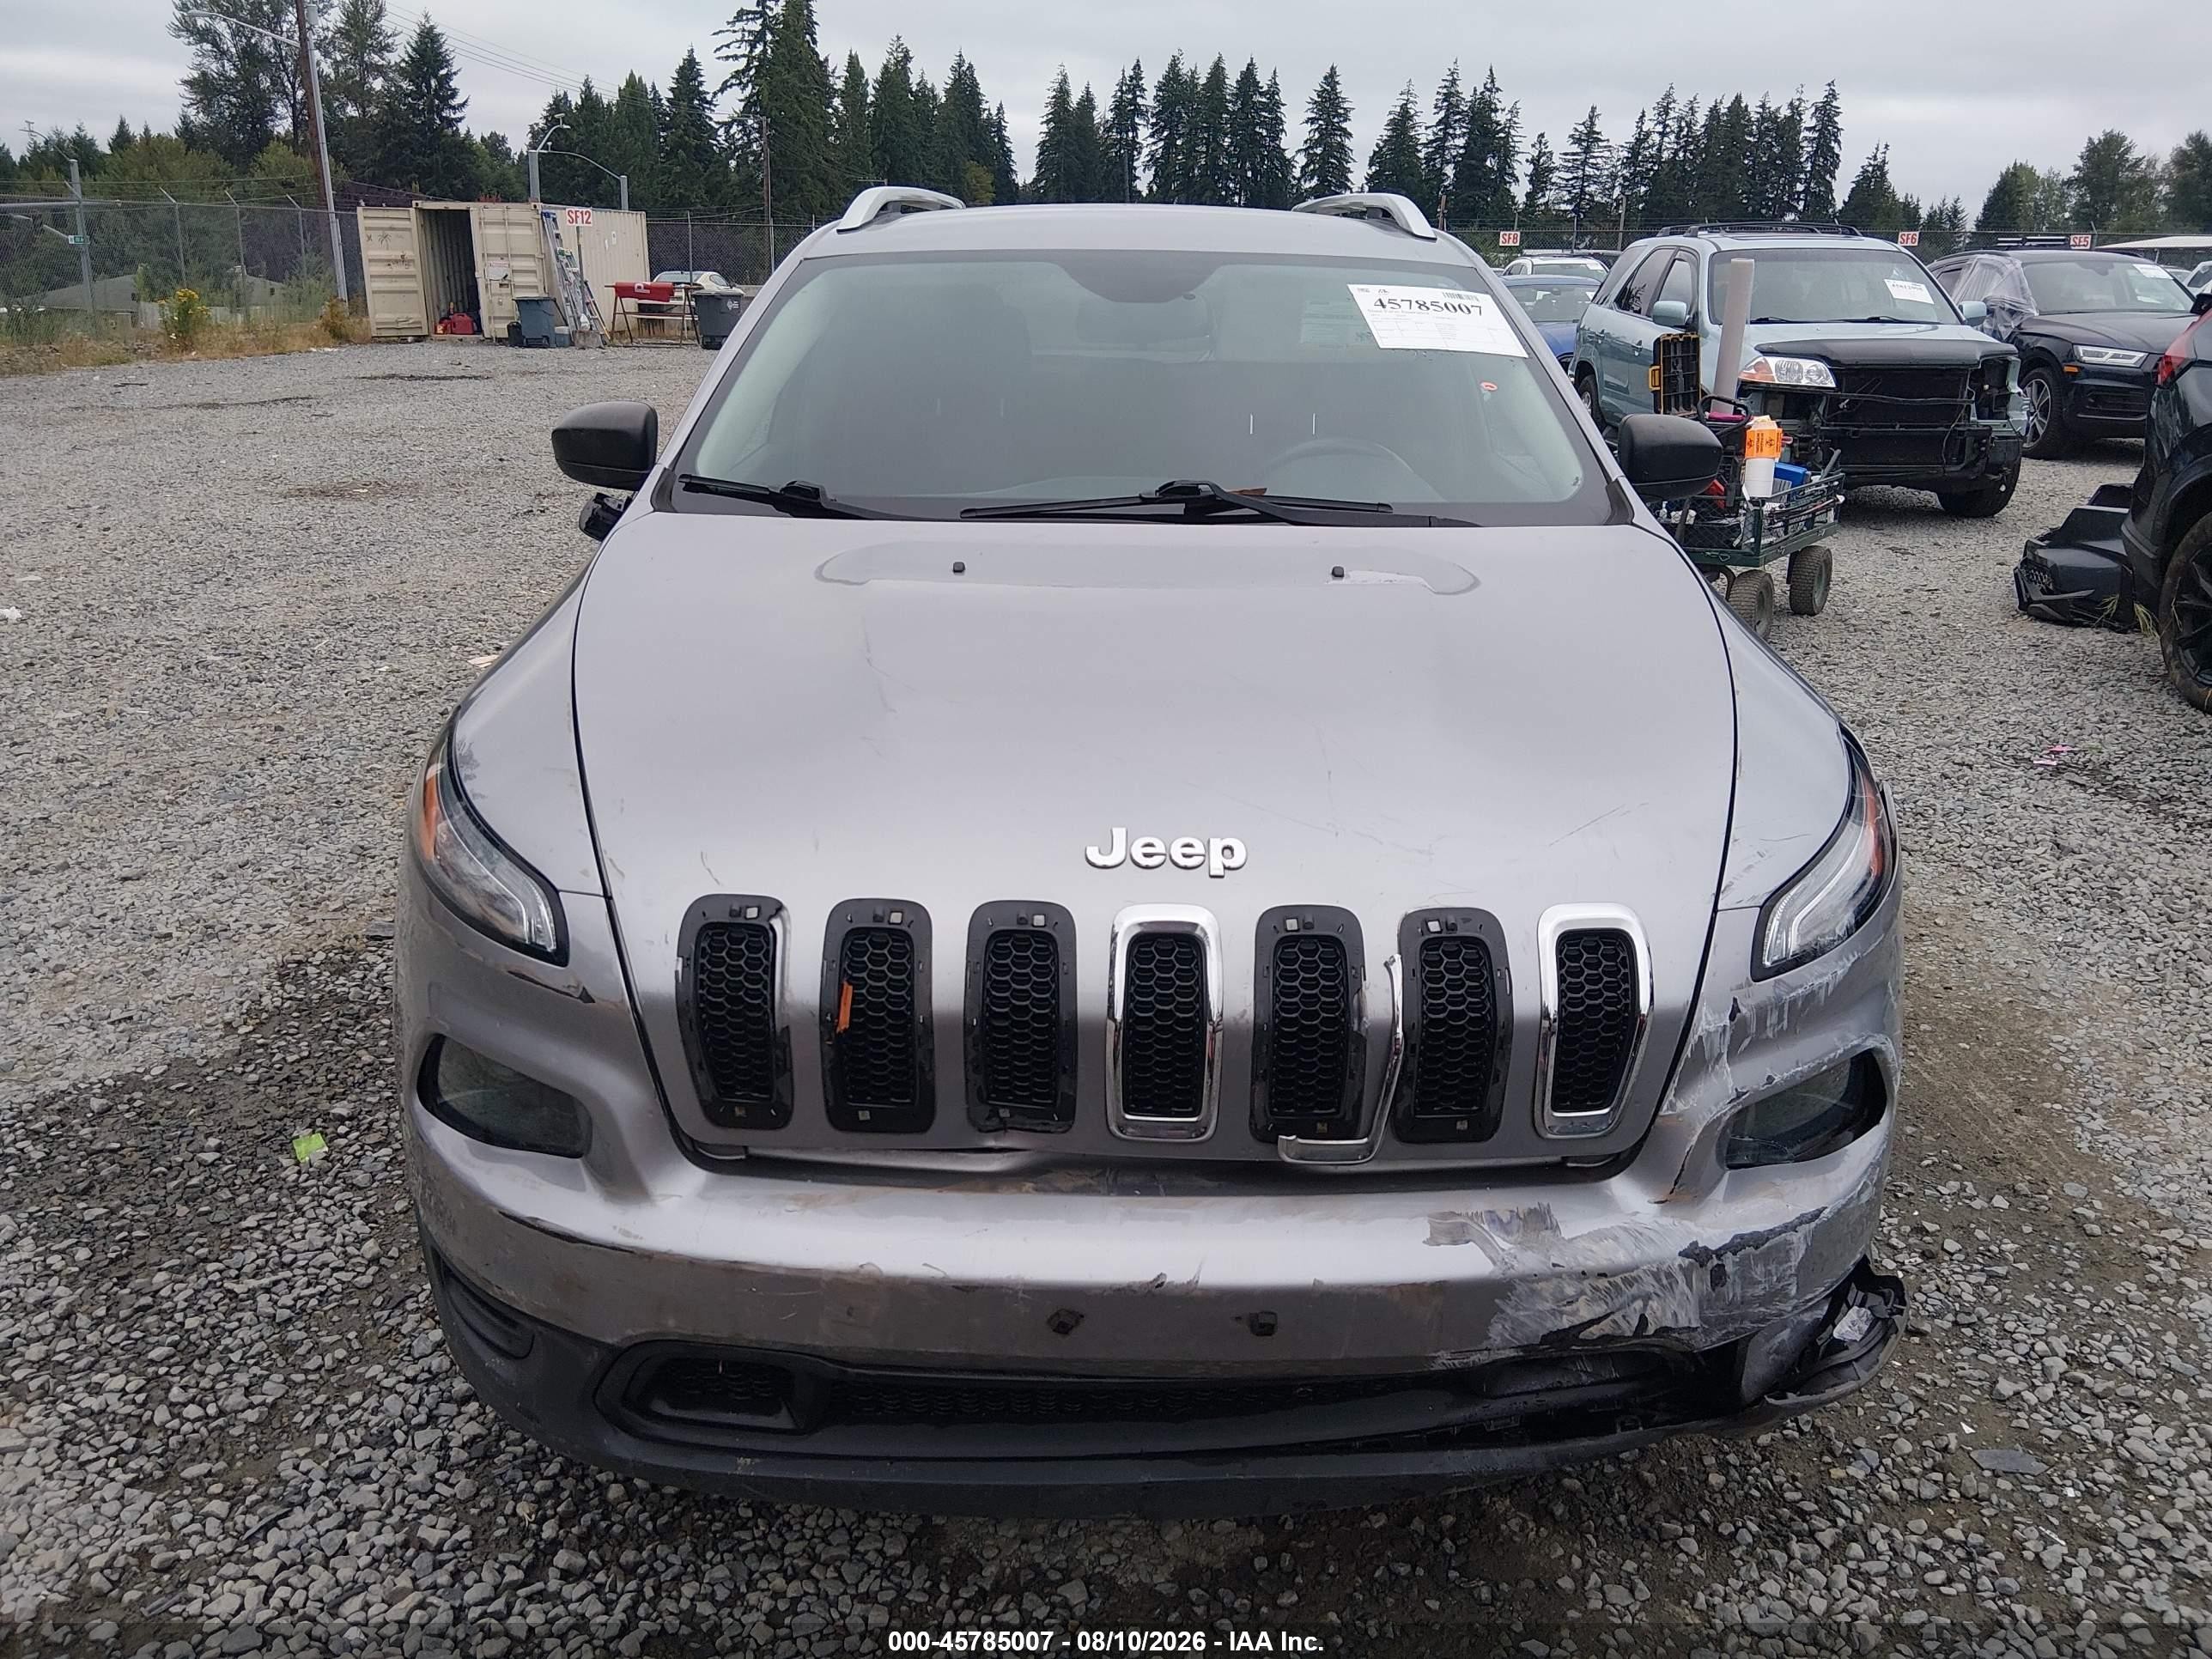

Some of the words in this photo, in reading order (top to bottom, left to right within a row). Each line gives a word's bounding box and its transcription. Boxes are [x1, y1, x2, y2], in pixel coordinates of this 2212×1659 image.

[567, 210, 592, 224] SF12
[1501, 233, 1518, 245] SF8
[1899, 233, 1917, 245] SF6
[1374, 298, 1482, 316] 45785007
[1085, 827, 1247, 878] Jeep
